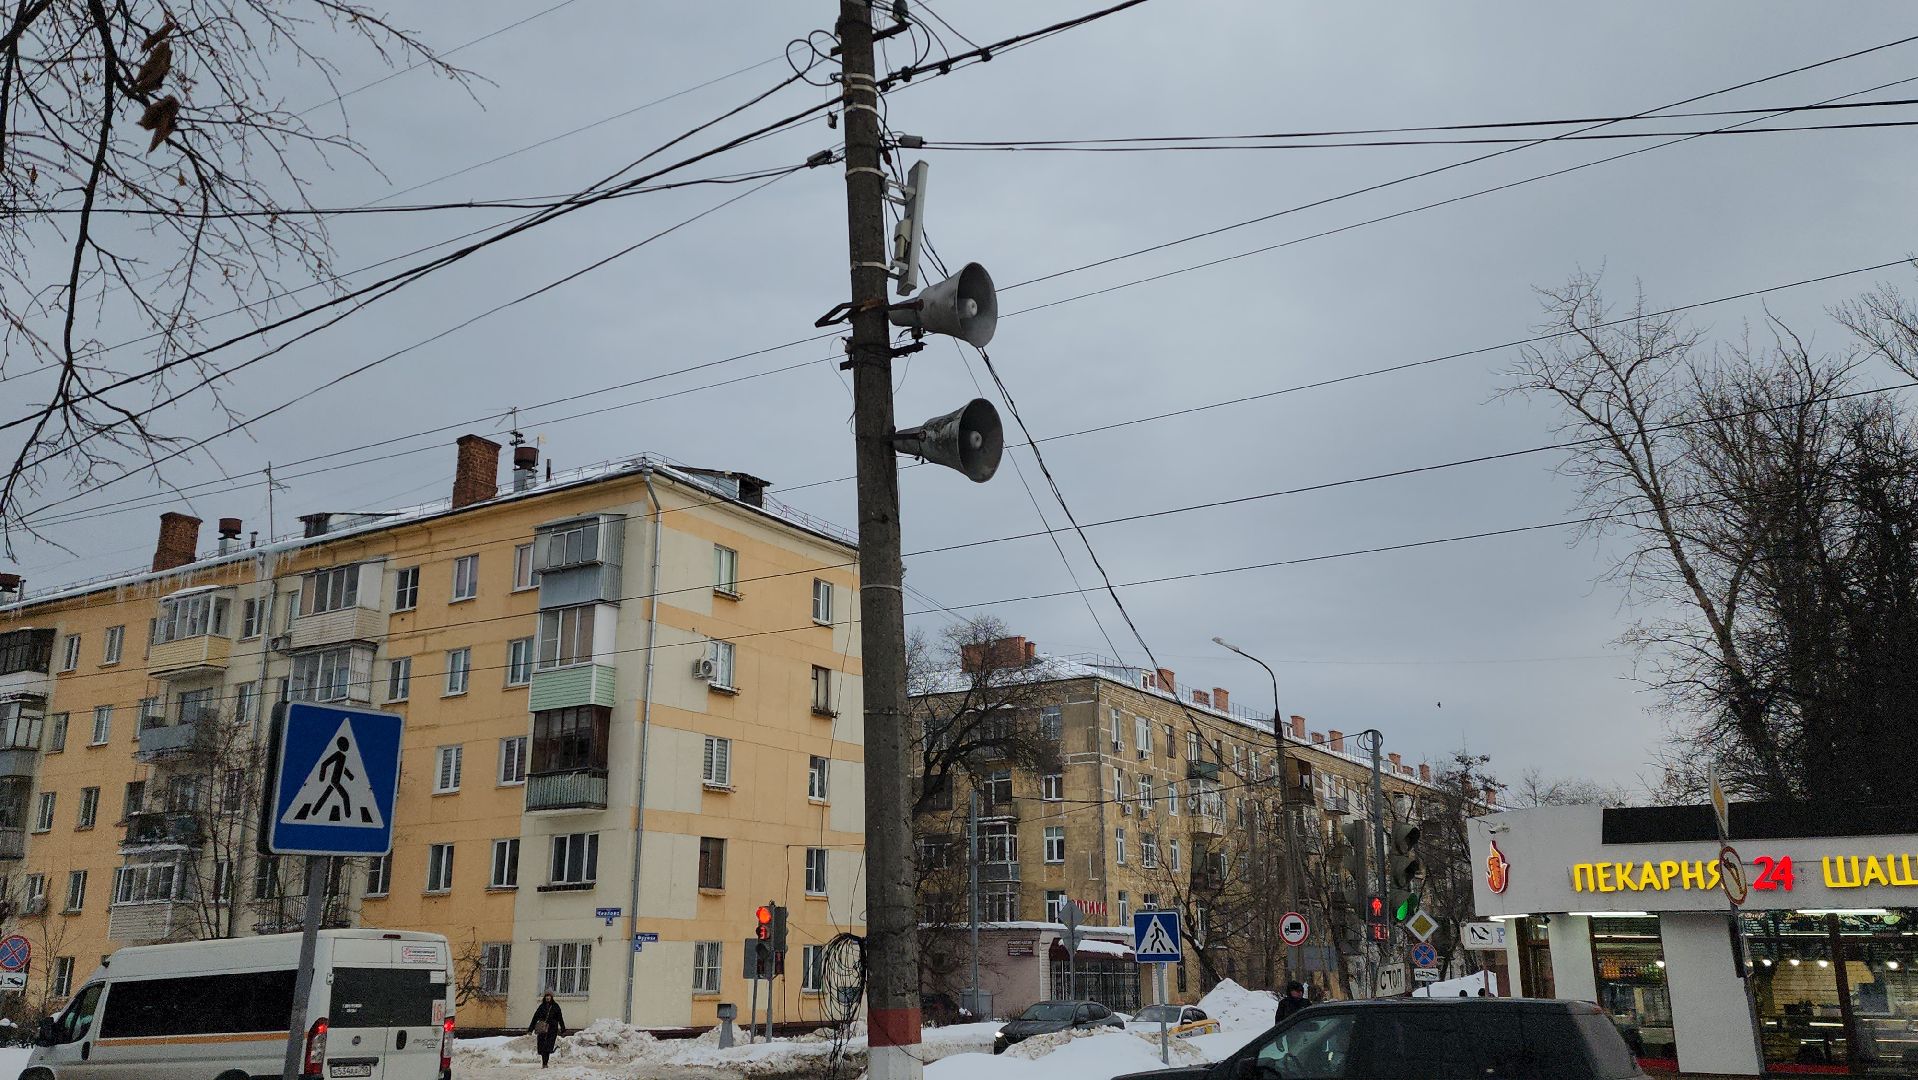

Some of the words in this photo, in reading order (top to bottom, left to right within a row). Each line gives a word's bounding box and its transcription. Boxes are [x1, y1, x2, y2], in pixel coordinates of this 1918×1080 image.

[1573, 859, 1725, 893] ПЕКАРНЯ
[1752, 855, 1795, 891] 24
[1380, 968, 1403, 990] СТОП
